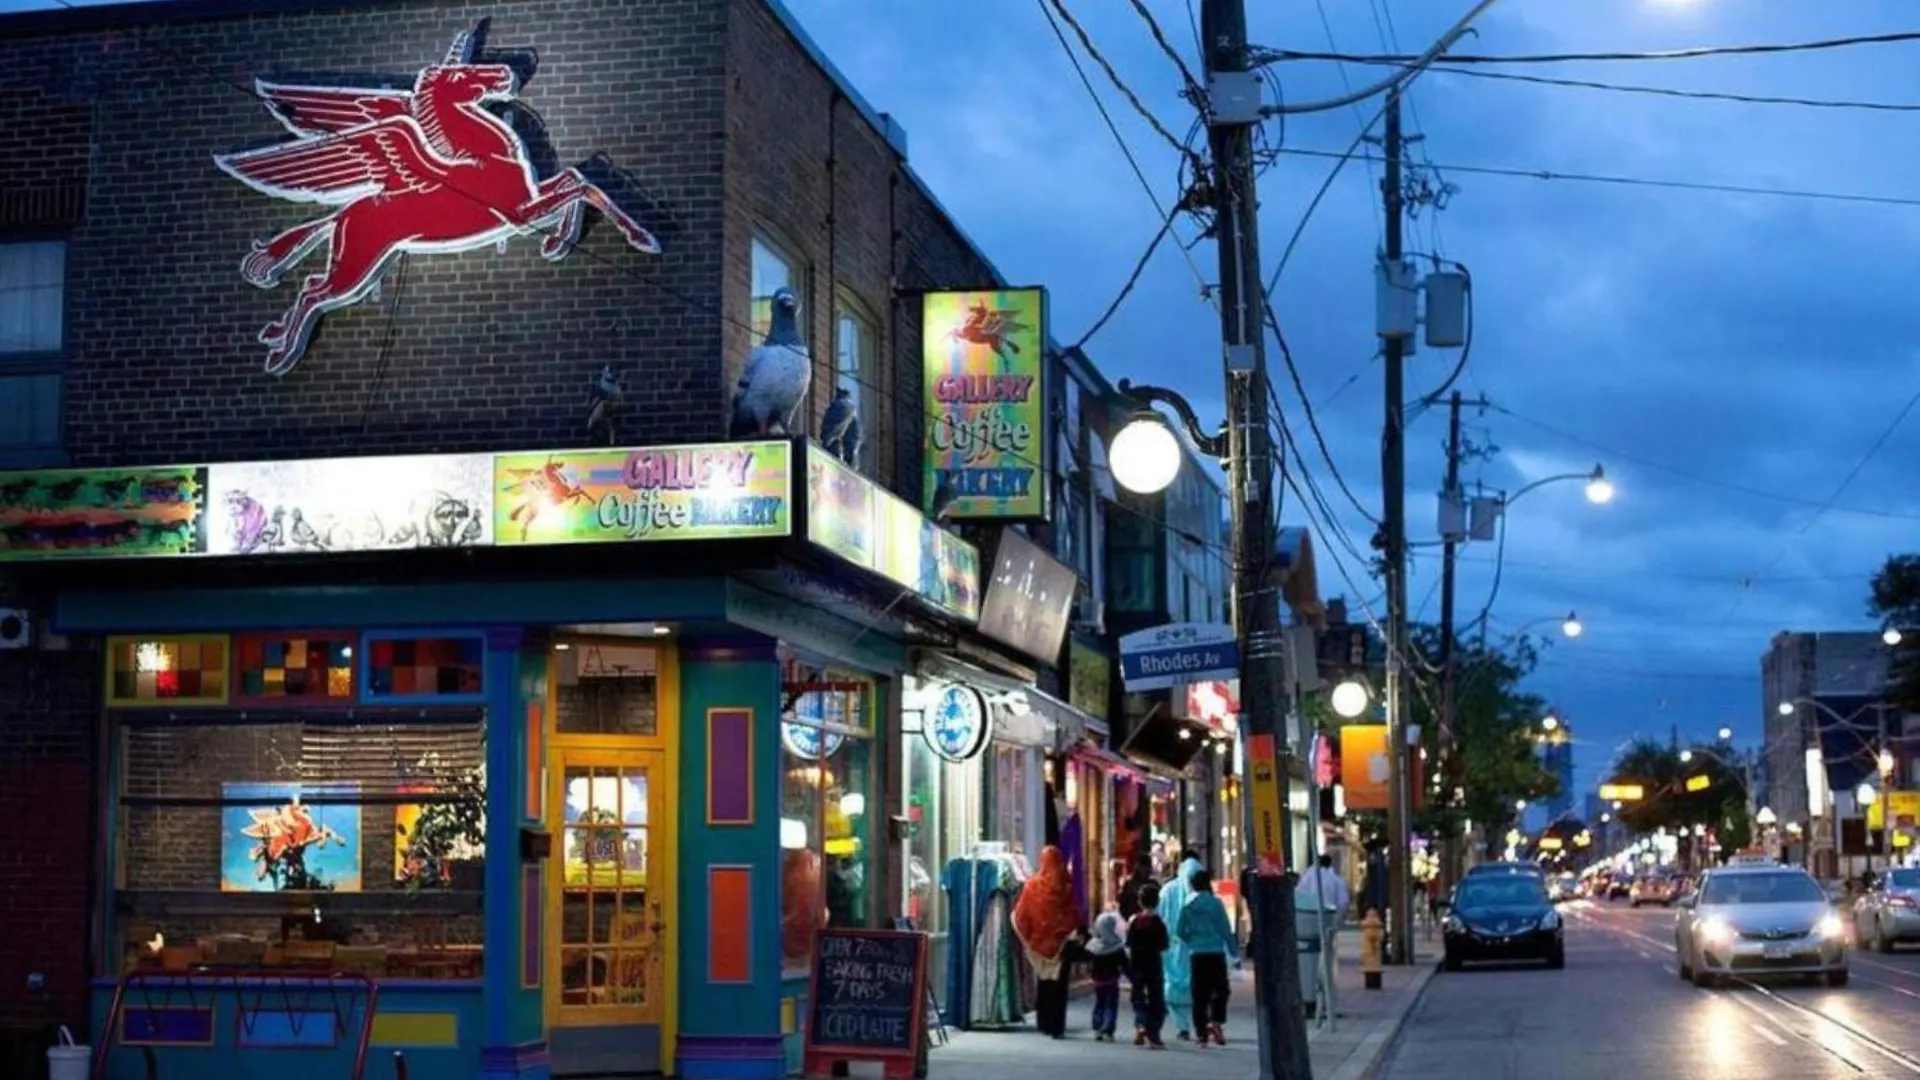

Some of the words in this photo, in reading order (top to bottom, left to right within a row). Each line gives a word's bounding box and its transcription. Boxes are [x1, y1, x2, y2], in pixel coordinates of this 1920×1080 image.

[932, 374, 1035, 404] GALLERY
[933, 407, 1031, 464] Coffee
[623, 448, 754, 490] GALLERY
[598, 487, 687, 538] Coffee
[690, 494, 783, 527] BAKERY
[1140, 651, 1202, 675] Rhodes
[876, 963, 914, 985] FRESH
[832, 980, 846, 1001] 7
[850, 981, 886, 1000] DAYS
